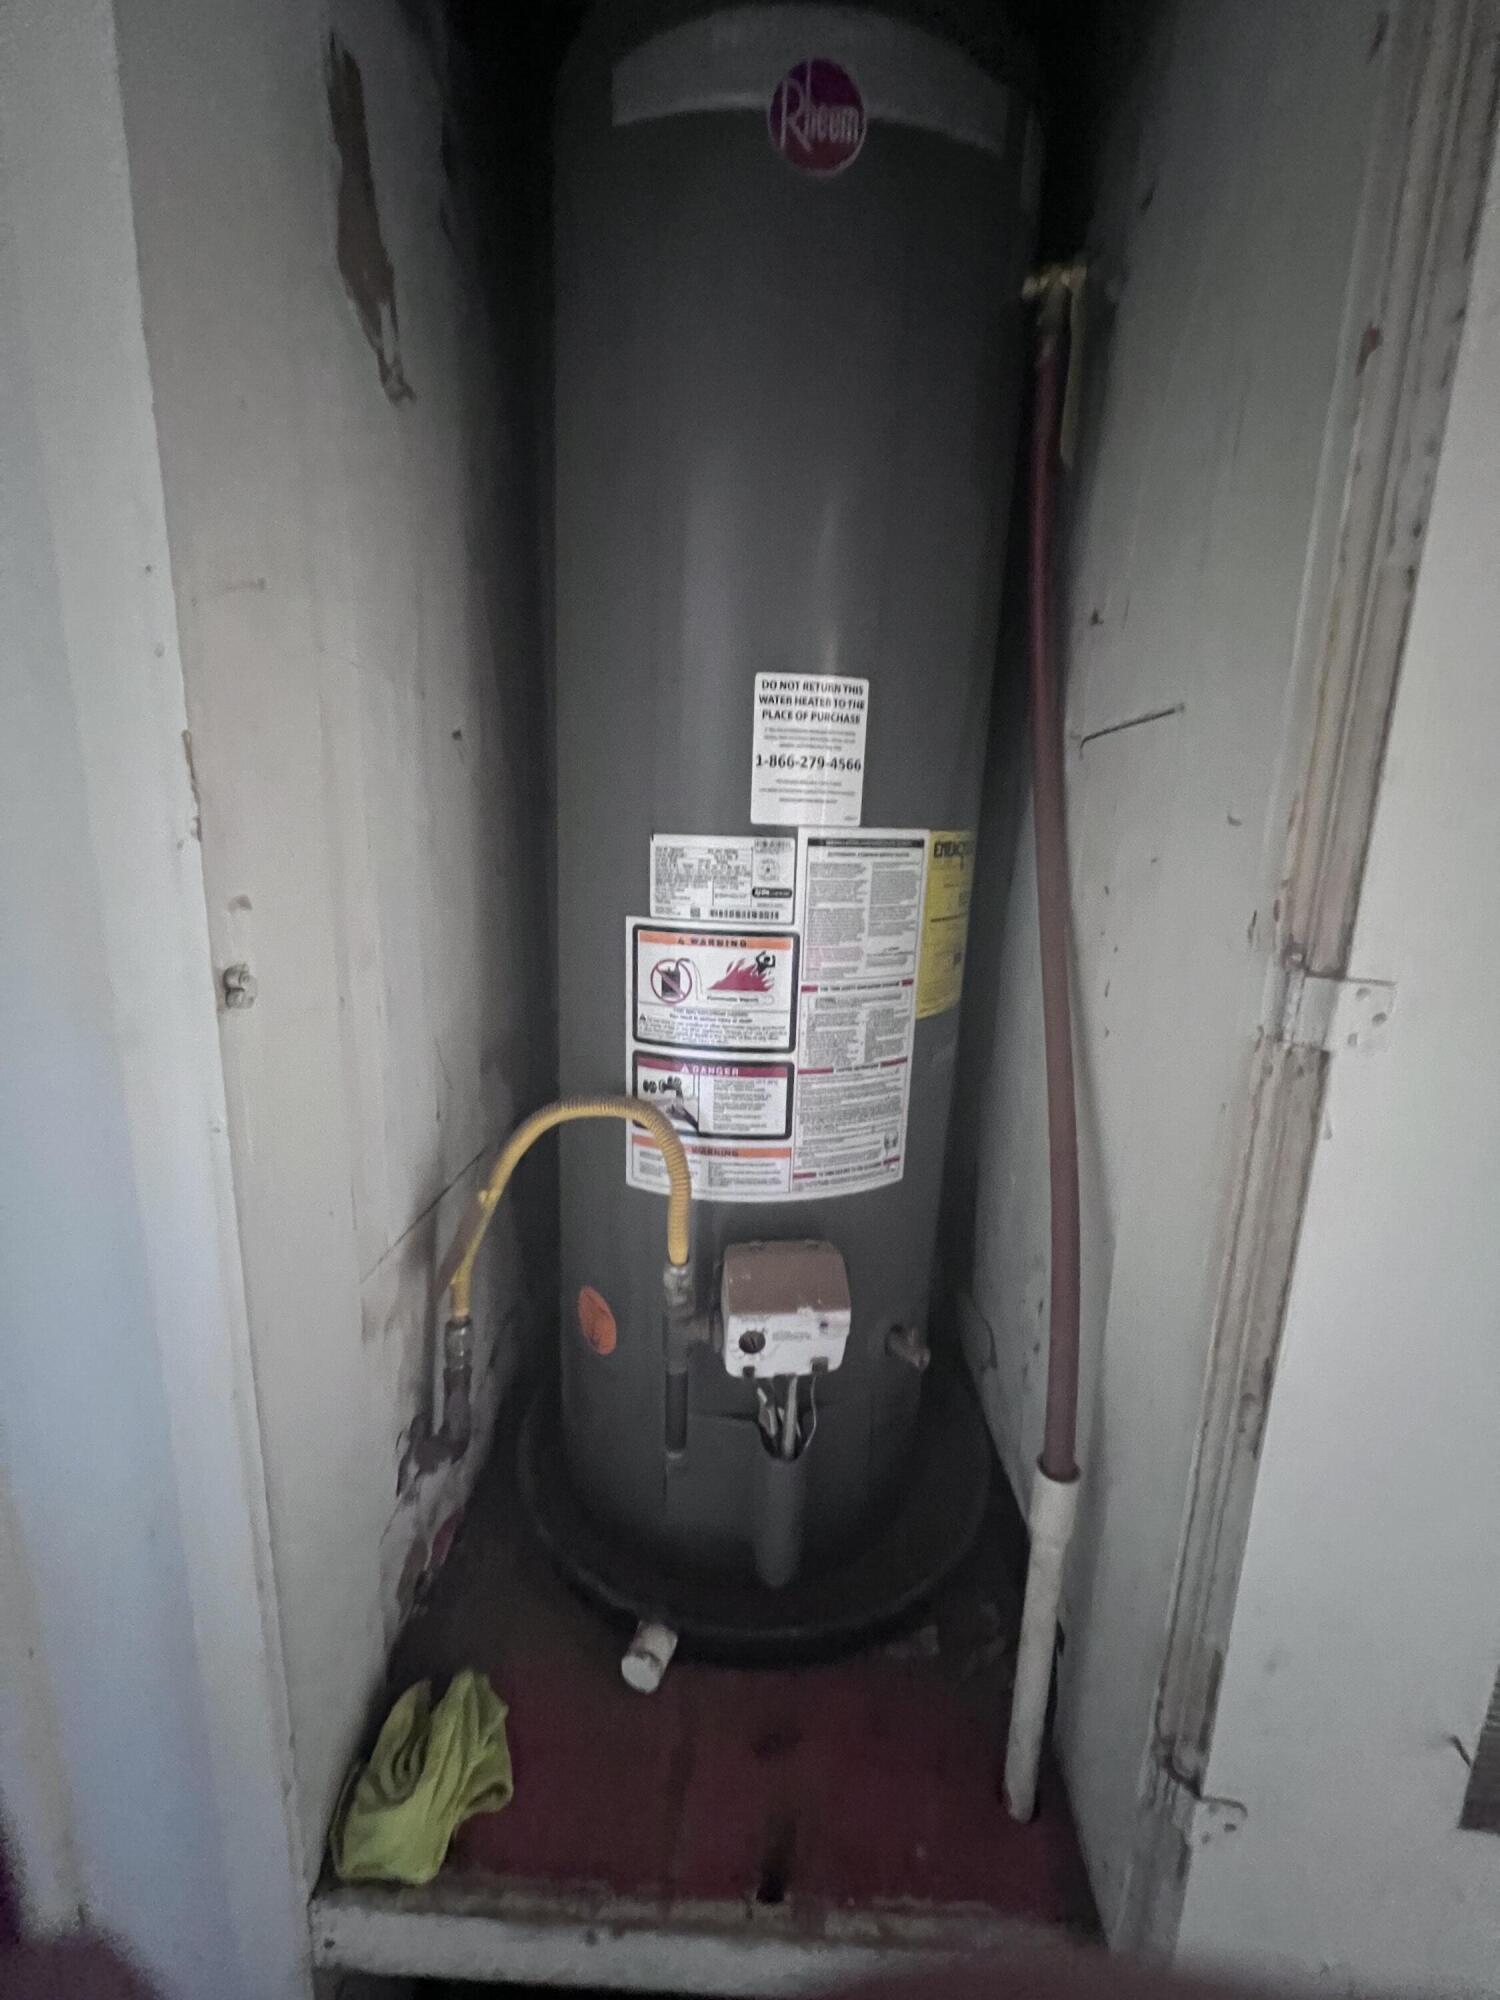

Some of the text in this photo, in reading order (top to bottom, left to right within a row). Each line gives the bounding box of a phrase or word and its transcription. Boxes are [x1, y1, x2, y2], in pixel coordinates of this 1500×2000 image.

[779, 58, 860, 152] Rheem
[761, 679, 864, 696] DO NOT RETURN THIS
[758, 694, 792, 705] WATER
[794, 696, 831, 708] HEATER
[833, 699, 846, 708] TO
[761, 709, 860, 724] PLACE OF PURCHASE
[690, 937, 748, 948] WARNING
[692, 1065, 739, 1077] DANGER
